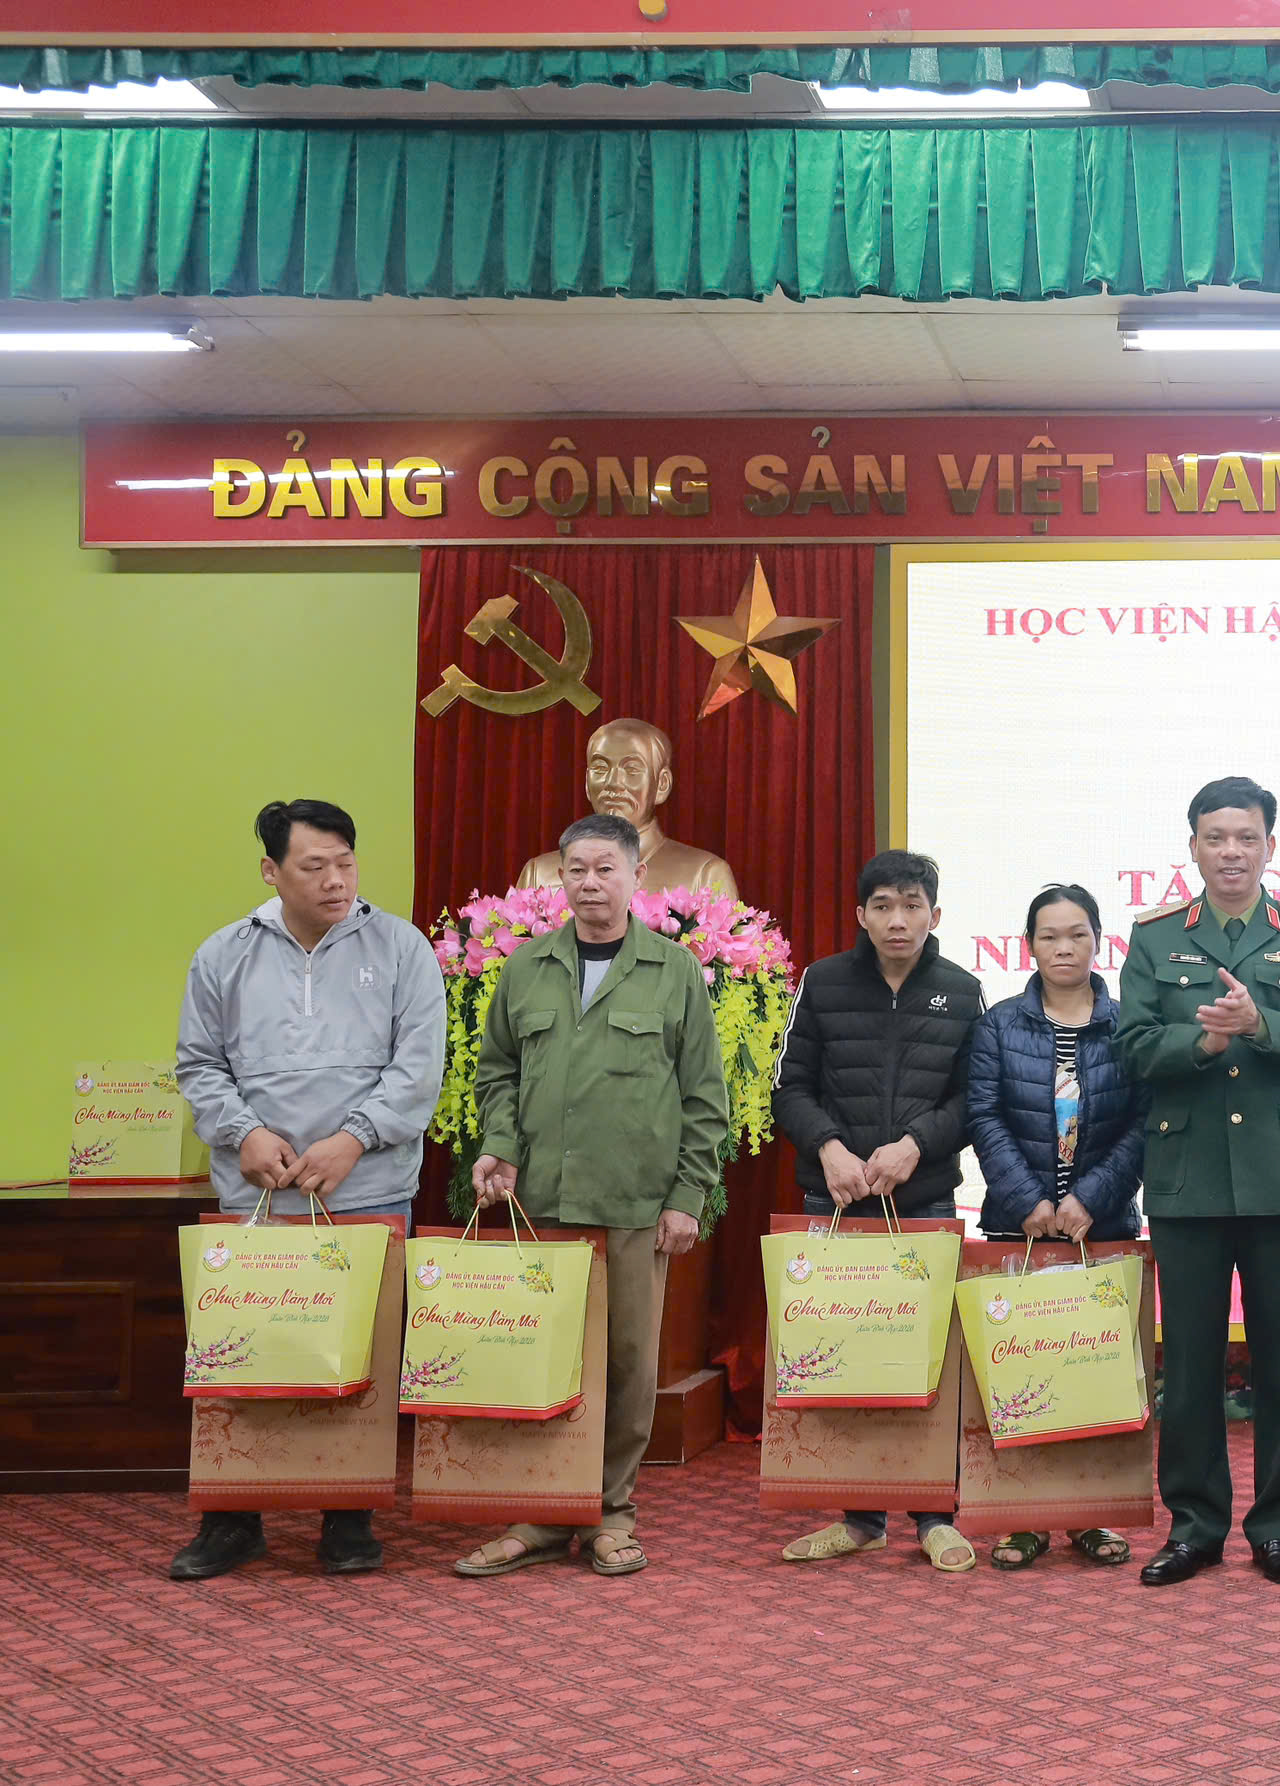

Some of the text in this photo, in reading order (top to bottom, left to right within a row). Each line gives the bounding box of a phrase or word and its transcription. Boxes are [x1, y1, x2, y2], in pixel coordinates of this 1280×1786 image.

[209, 429, 444, 518] ĐẢNG
[478, 437, 709, 534] CỘNG
[744, 426, 907, 516] SẢN
[938, 435, 1113, 534] VIỆT
[983, 606, 1086, 644] HỌC
[1097, 603, 1209, 643] VIỆN
